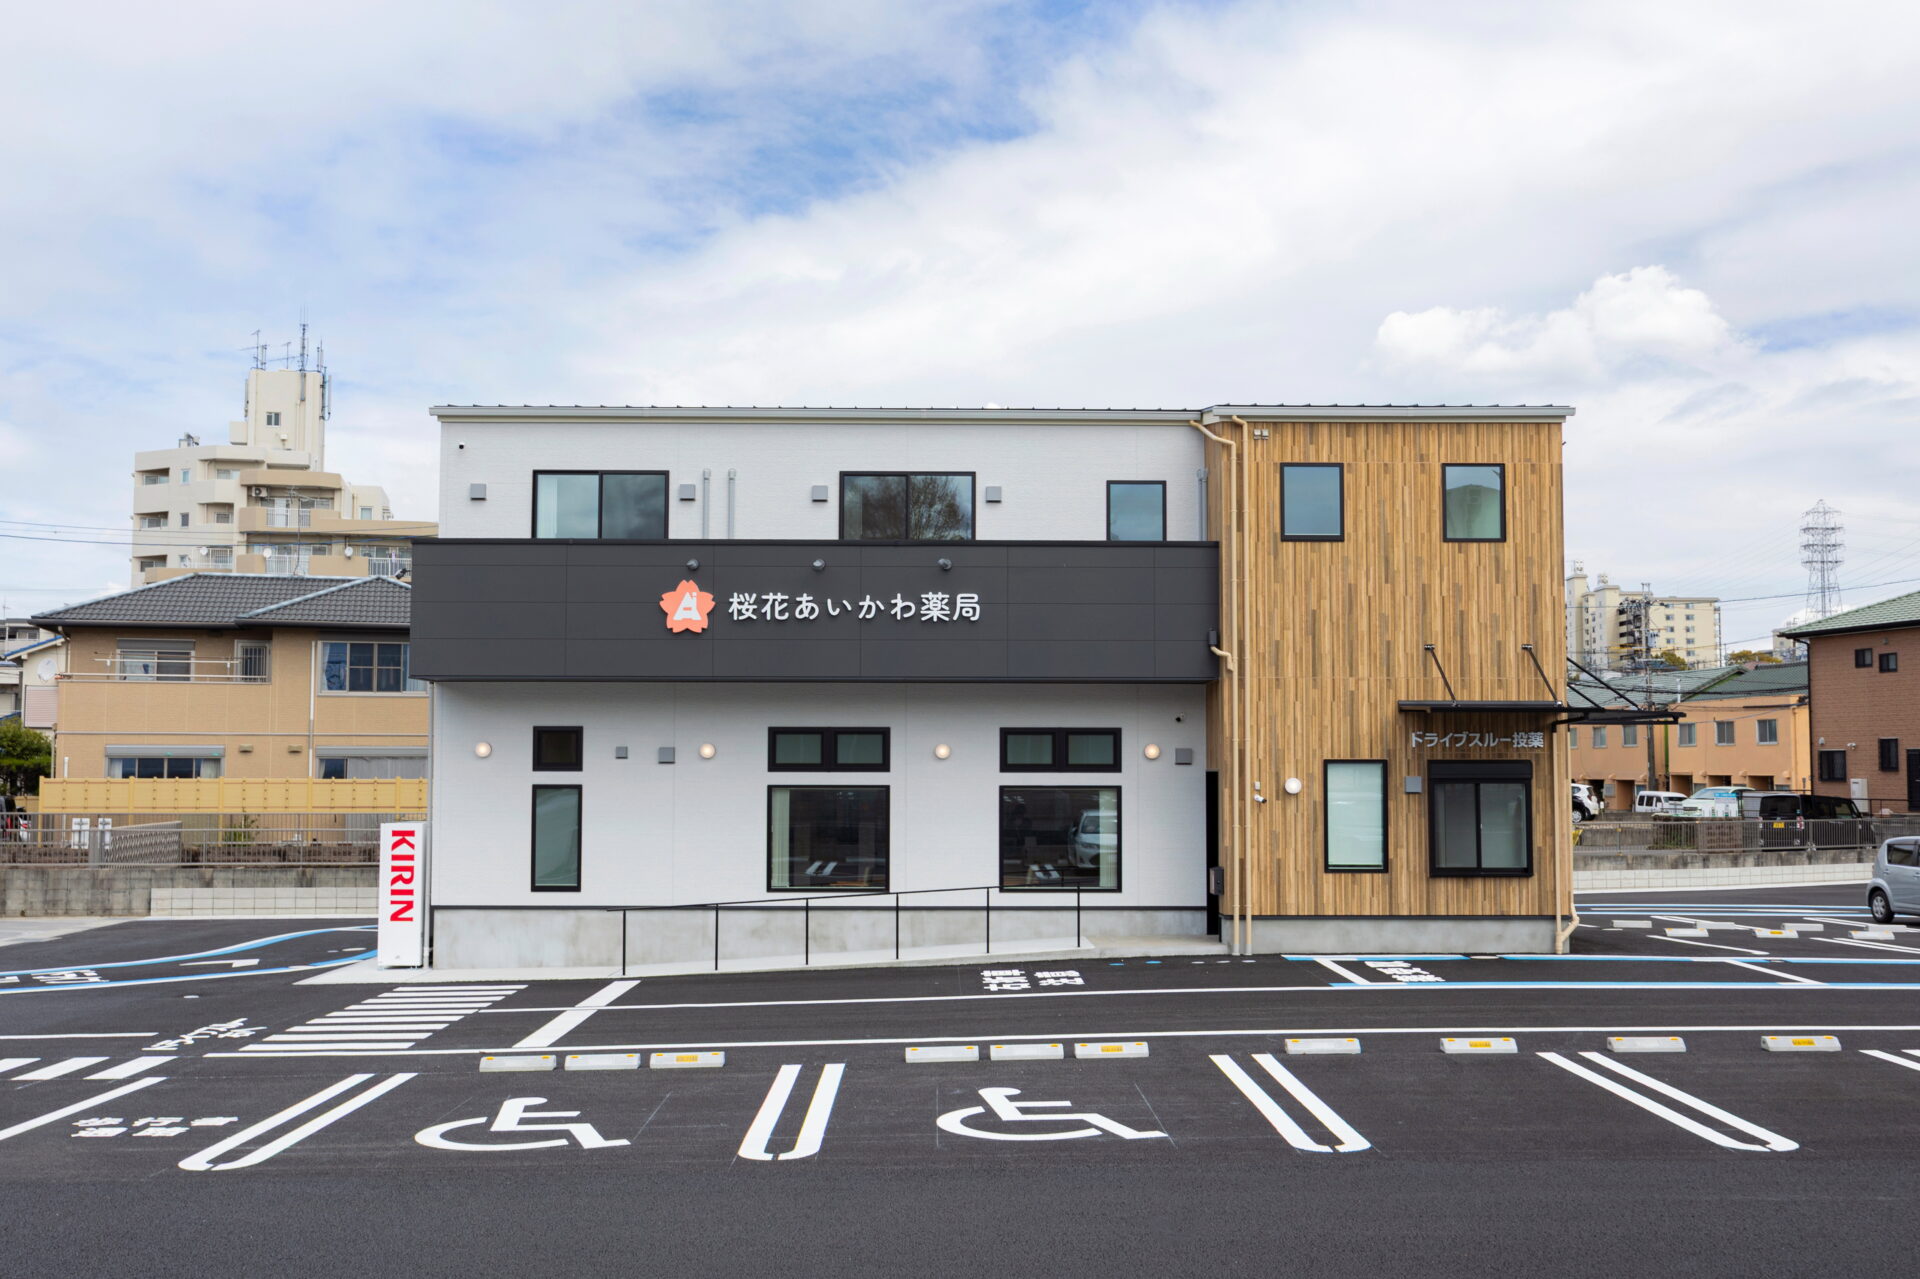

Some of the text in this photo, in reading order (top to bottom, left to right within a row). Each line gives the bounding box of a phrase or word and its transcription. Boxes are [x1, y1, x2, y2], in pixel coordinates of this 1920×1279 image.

[728, 592, 981, 622] 桜花あいかわ薬局
[1411, 731, 1544, 748] ドライブスルー投薬
[390, 830, 416, 922] KIRIN
